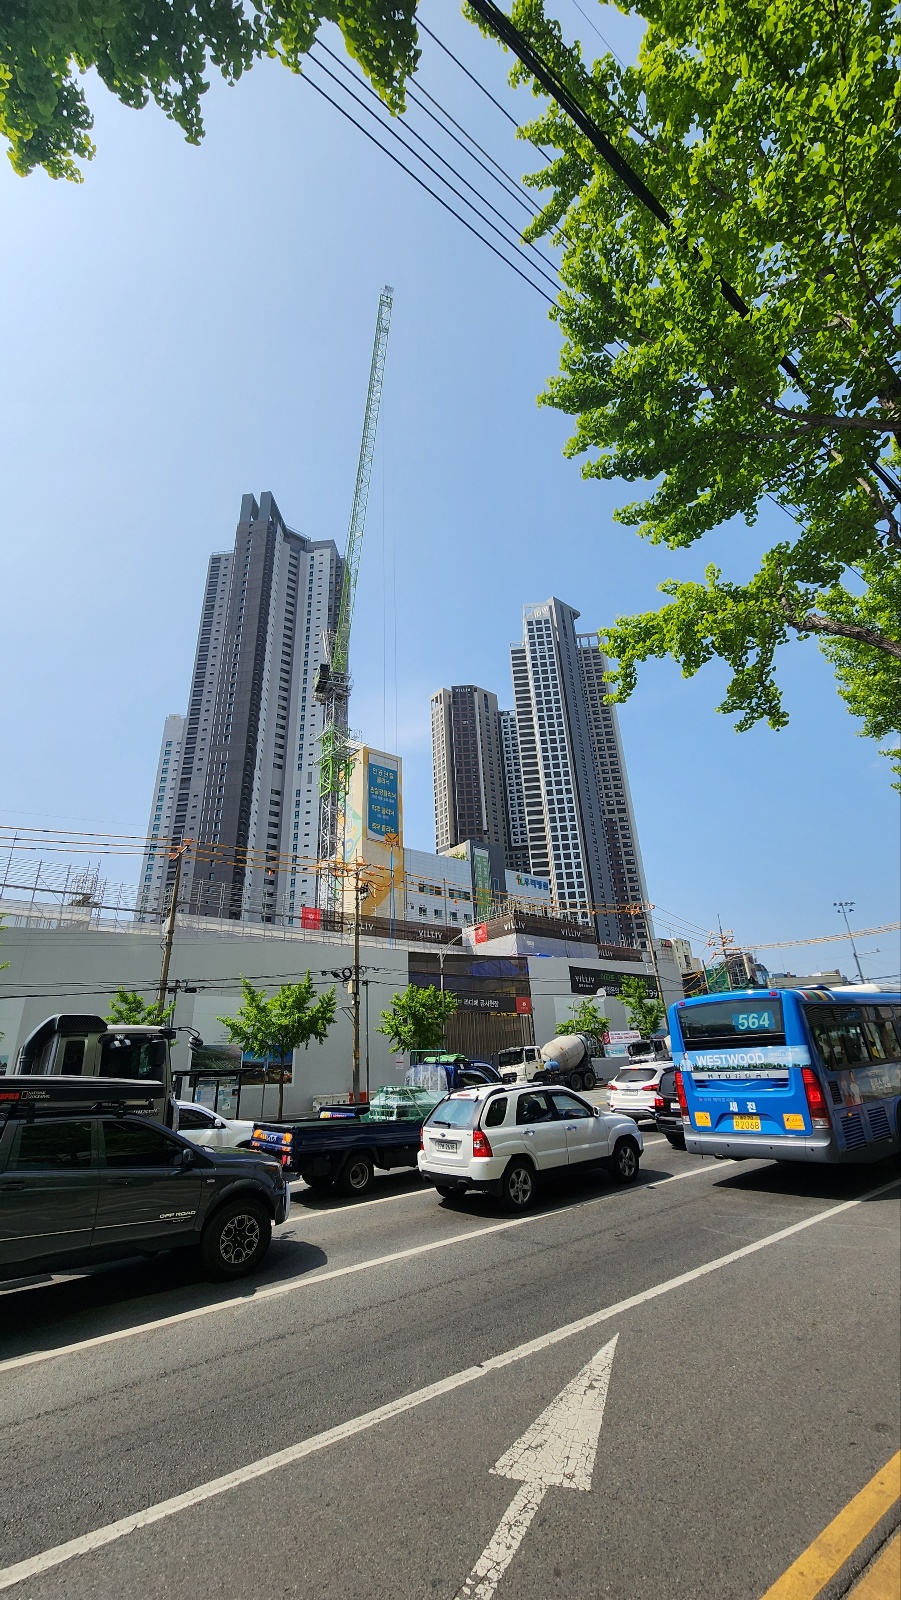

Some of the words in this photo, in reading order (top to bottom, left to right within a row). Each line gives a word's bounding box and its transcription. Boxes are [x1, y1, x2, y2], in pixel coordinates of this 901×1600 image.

[524, 877, 549, 890] 우리병원
[560, 927, 581, 938] VILLIV
[574, 973, 595, 985] VILLIV
[479, 999, 500, 1008] 공사현장
[738, 1012, 770, 1030] 564
[695, 1052, 765, 1066] WESTWOOD
